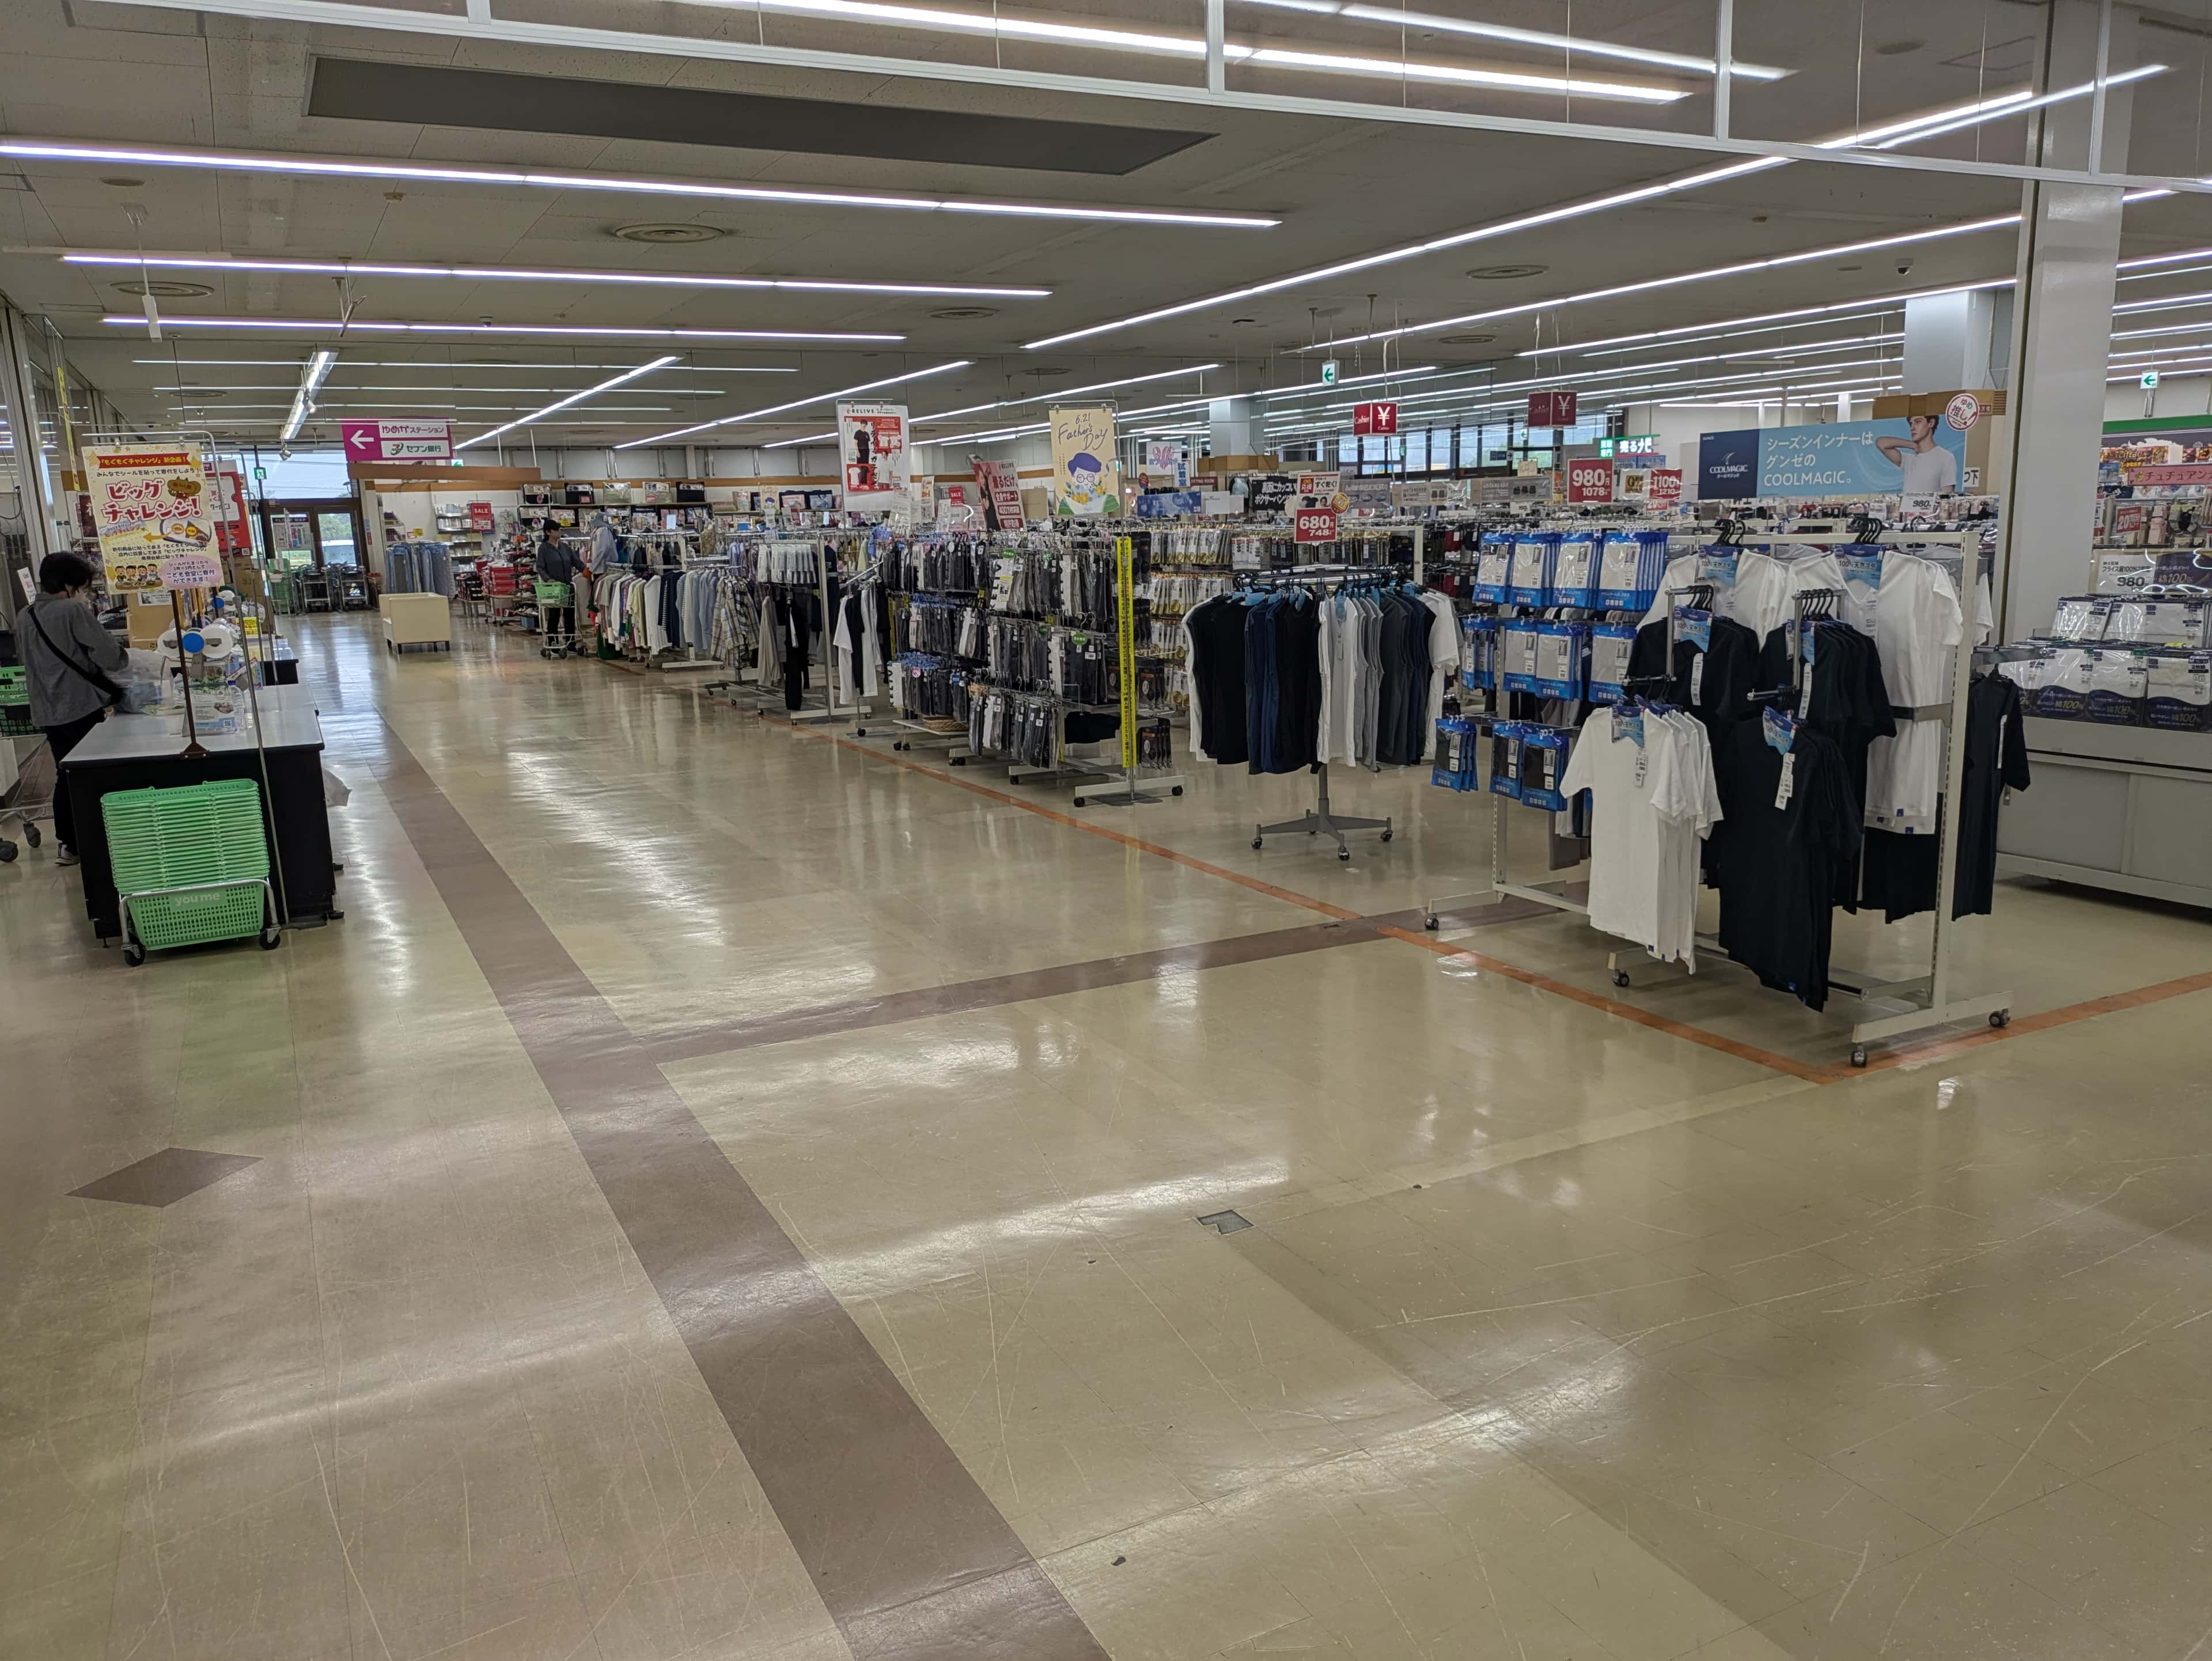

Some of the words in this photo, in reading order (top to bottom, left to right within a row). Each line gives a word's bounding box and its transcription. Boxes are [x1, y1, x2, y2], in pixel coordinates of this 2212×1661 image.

[1075, 413, 1090, 424] 6.21
[1354, 415, 1369, 424] Cashier
[1058, 423, 1092, 445] Father's
[1082, 429, 1108, 451] Day
[1767, 432, 1873, 451] シーズンインナーは
[1619, 437, 1653, 453] 売るナビ
[1710, 464, 1748, 474] COOLMAGIC
[1766, 453, 1816, 470] グンゼの
[106, 478, 165, 501] ビッグ
[102, 496, 202, 523] チャレンジ！
[166, 570, 215, 578] こども食堂に寄付
